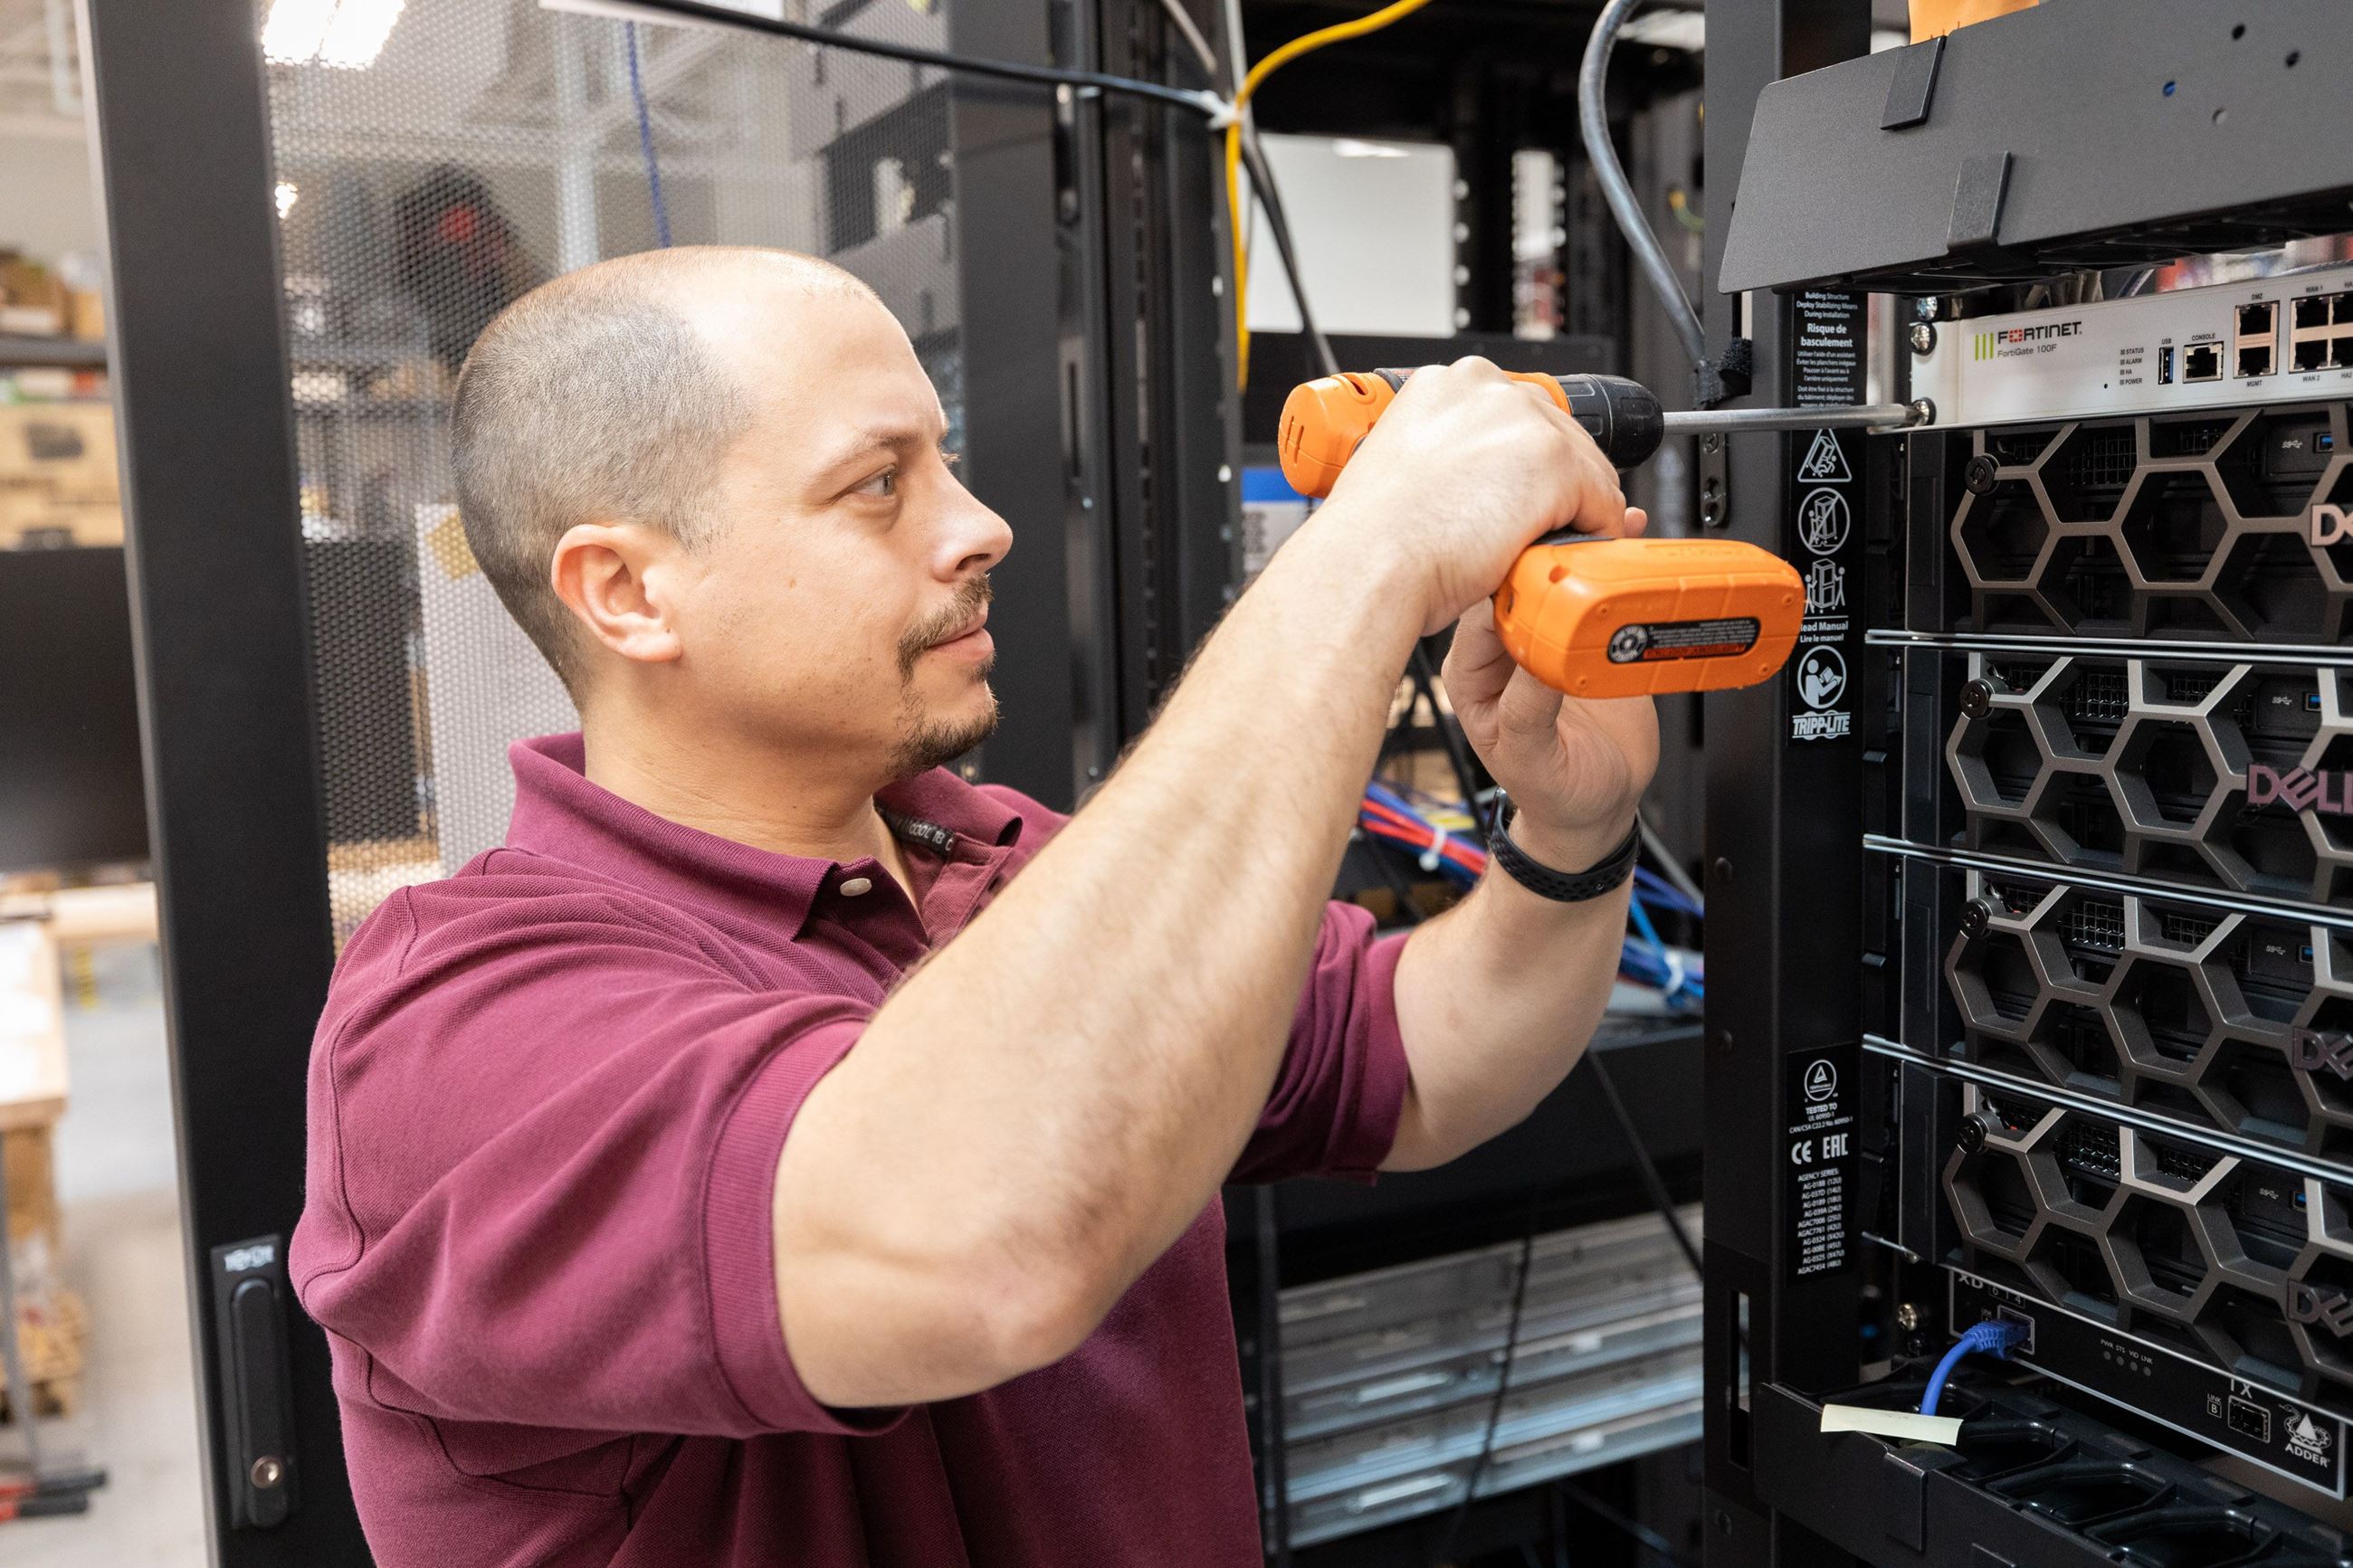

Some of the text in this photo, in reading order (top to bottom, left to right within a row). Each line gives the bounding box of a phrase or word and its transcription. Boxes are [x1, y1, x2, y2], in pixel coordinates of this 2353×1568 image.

[1805, 291, 1826, 300] Building
[1796, 300, 1815, 309] Deploy
[1815, 301, 1841, 310] Stabilizing
[1805, 309, 1822, 318] During
[1806, 322, 1847, 335] Risque de
[1997, 321, 2082, 344] FORTINET
[1801, 336, 1853, 347] basculement
[2192, 333, 2215, 341] CONSOLE
[1997, 344, 2057, 358] FortiGate 100F
[2125, 377, 2143, 385] POWER
[1819, 621, 1848, 632] Manual
[1820, 633, 1844, 642] manuel
[932, 831, 945, 844] 18
[1805, 1102, 1837, 1115] TESTED TO
[1792, 1140, 1812, 1165] CE
[1797, 1172, 1819, 1182] AGENCY
[2101, 1338, 2154, 1364] PWR STS VID LNK
[2207, 1393, 2222, 1404] LINK
[2211, 1404, 2218, 1414] B
[2285, 1442, 2328, 1468] ADDER
